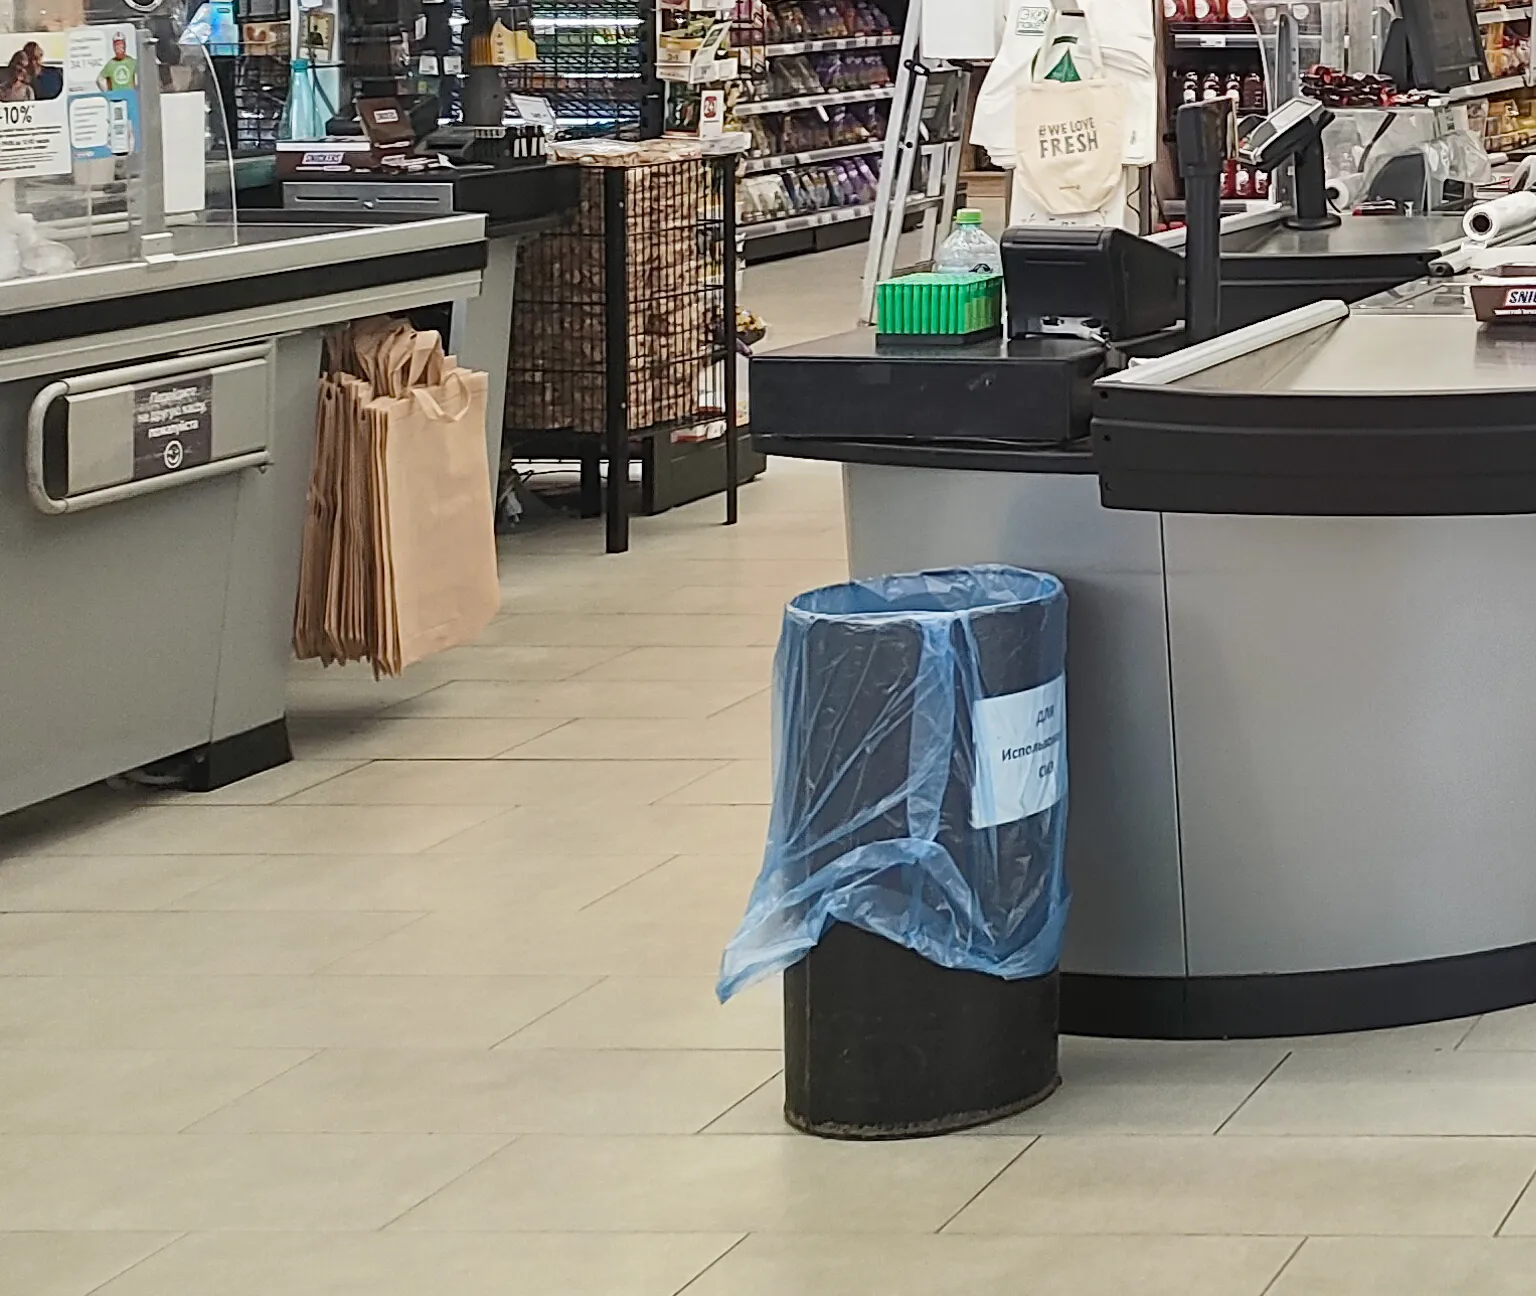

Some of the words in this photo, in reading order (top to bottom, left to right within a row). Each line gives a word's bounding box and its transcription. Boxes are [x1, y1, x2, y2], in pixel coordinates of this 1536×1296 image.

[1038, 122, 1067, 137] #WE
[1069, 117, 1096, 133] LOVE
[1040, 131, 1099, 159] FRESH
